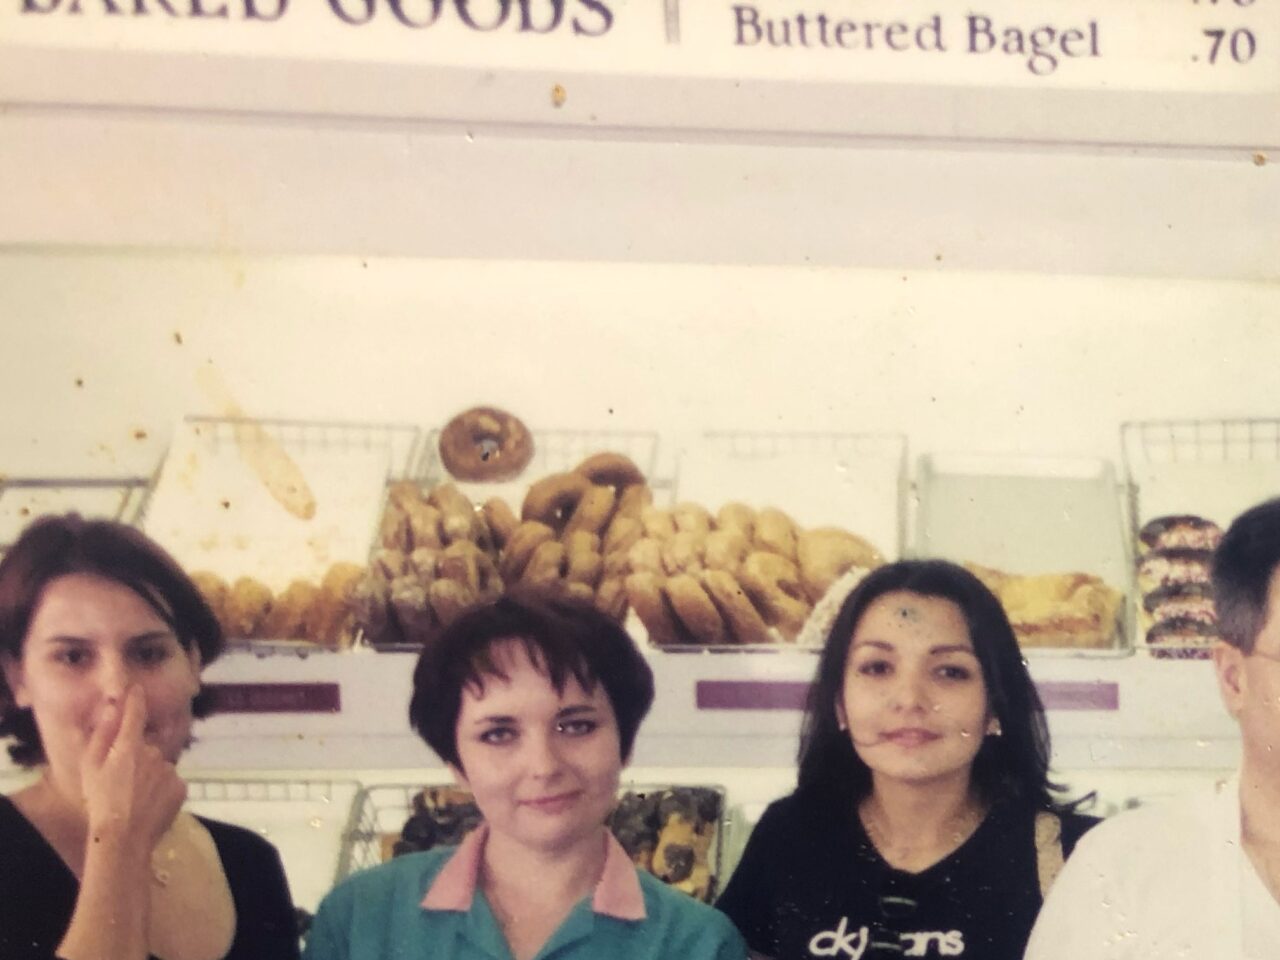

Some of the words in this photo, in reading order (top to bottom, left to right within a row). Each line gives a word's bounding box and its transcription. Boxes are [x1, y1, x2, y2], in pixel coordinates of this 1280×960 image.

[732, 6, 947, 53] Buttered
[965, 15, 1101, 76] Bagel
[1192, 28, 1256, 64] .70
